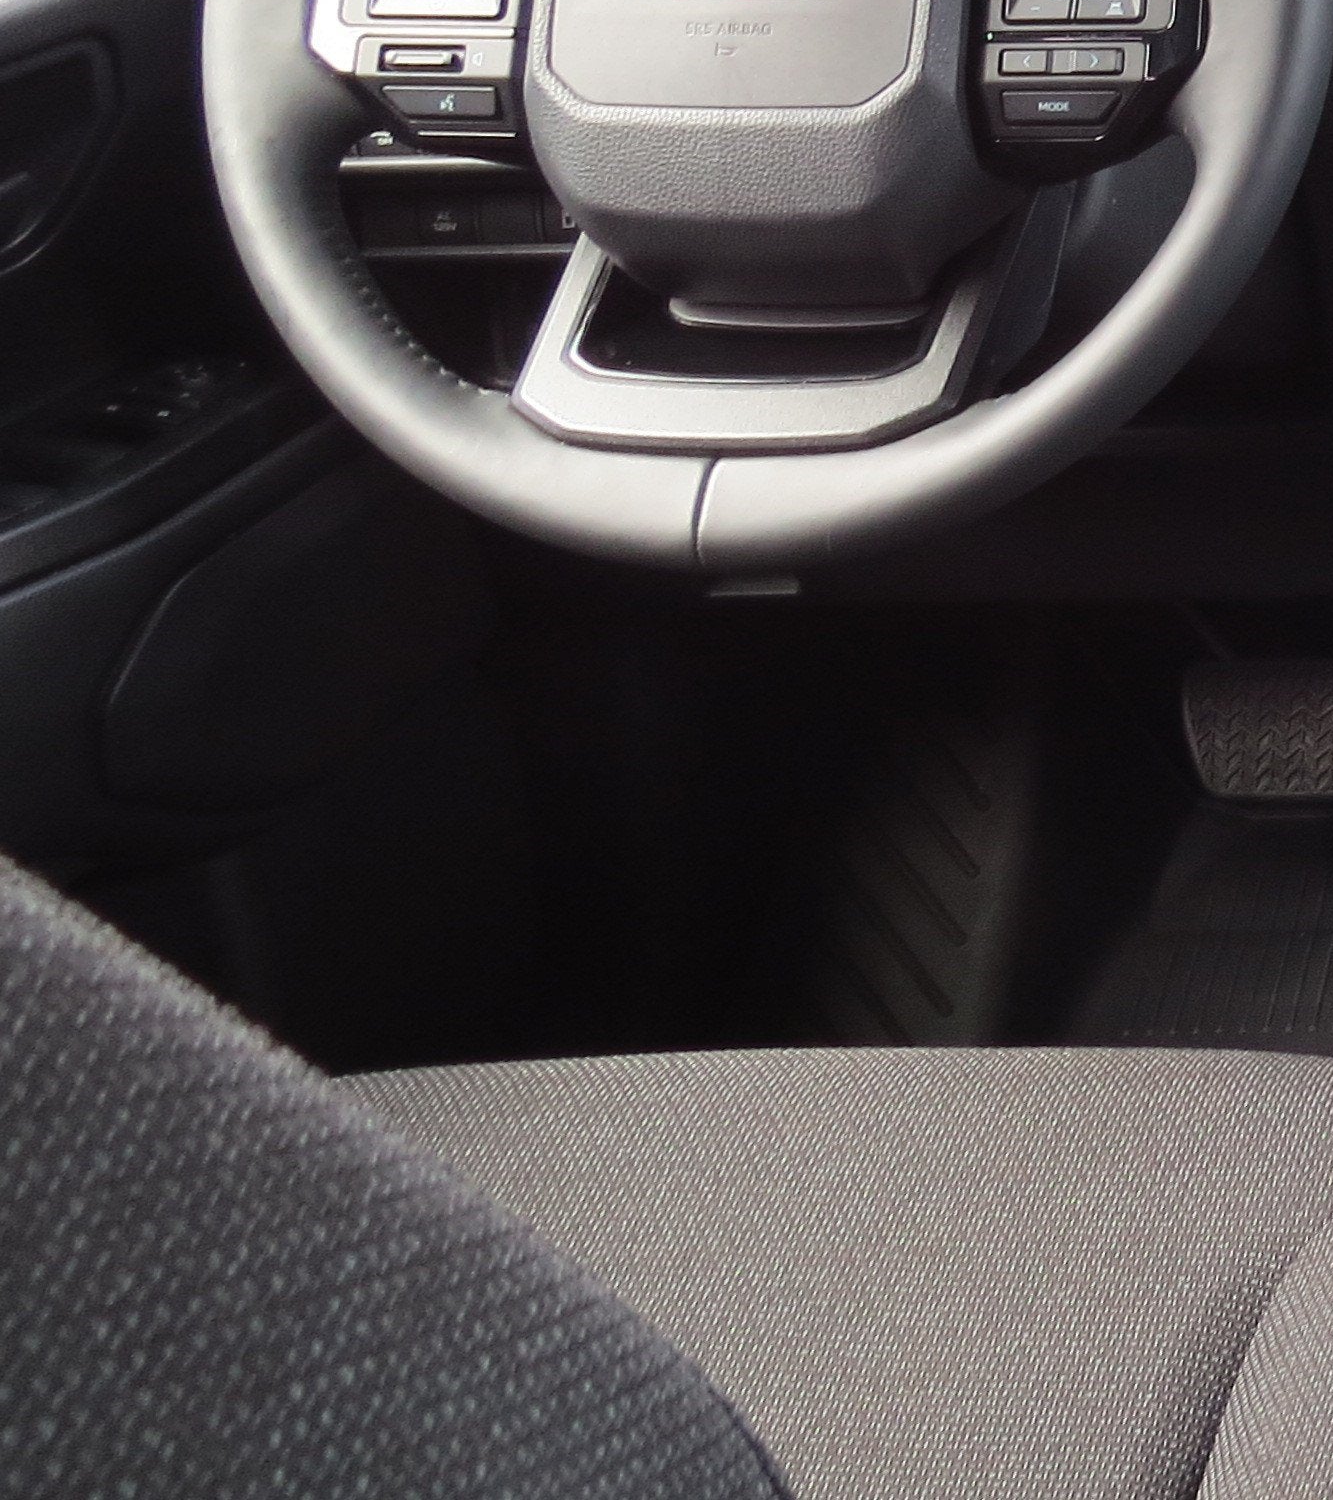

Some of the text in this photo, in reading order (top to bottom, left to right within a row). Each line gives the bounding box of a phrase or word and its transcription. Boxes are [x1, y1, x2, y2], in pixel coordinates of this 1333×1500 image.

[685, 21, 772, 37] SRS AIRBAG
[1037, 101, 1070, 113] MODE
